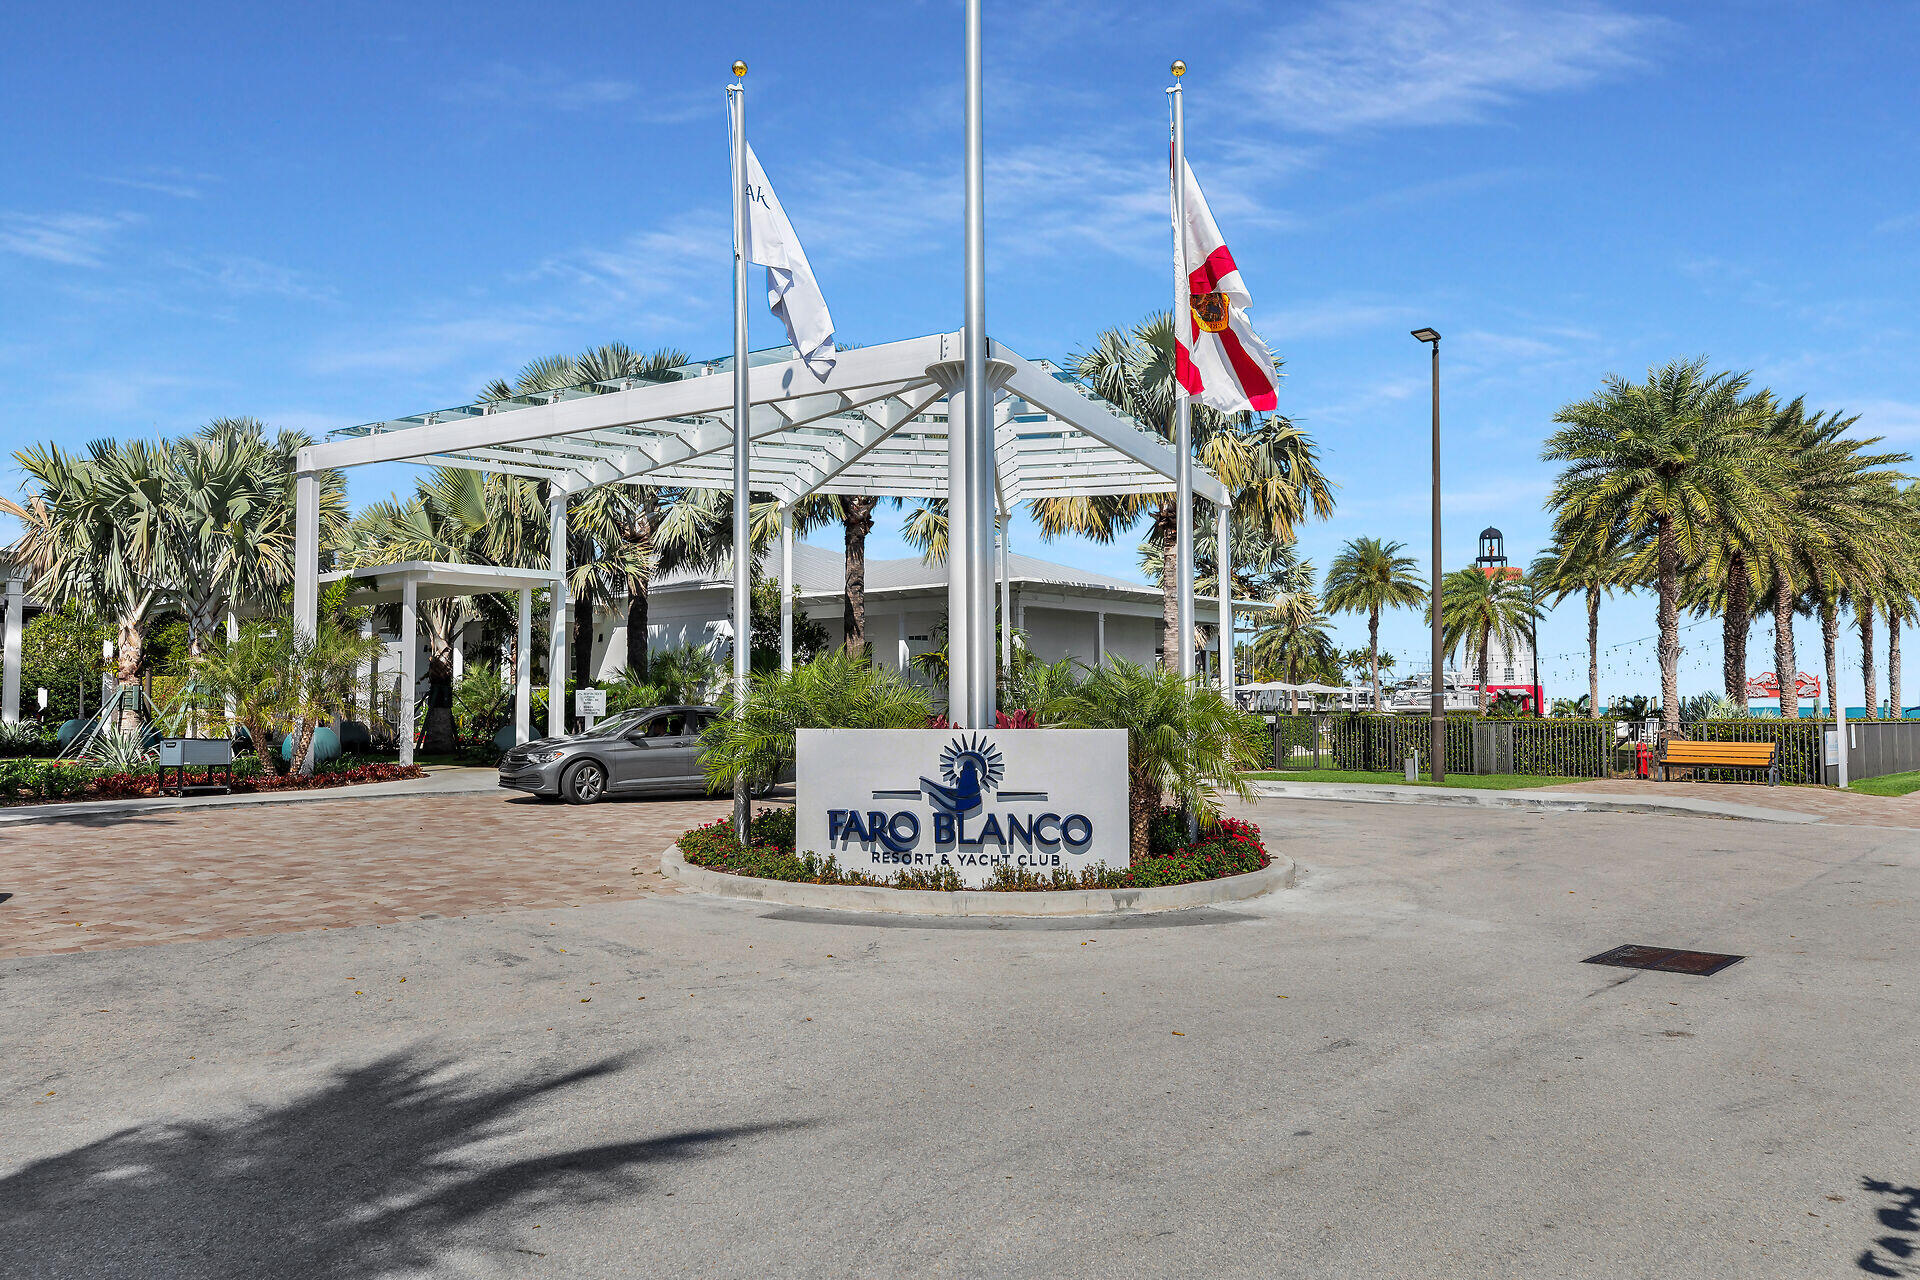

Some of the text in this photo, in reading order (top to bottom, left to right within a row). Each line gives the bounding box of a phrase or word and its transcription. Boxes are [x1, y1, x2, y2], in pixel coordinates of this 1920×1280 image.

[827, 809, 1093, 852] FARO BLANCO
[871, 851, 1061, 867] RESORT & YACHT CLUB
